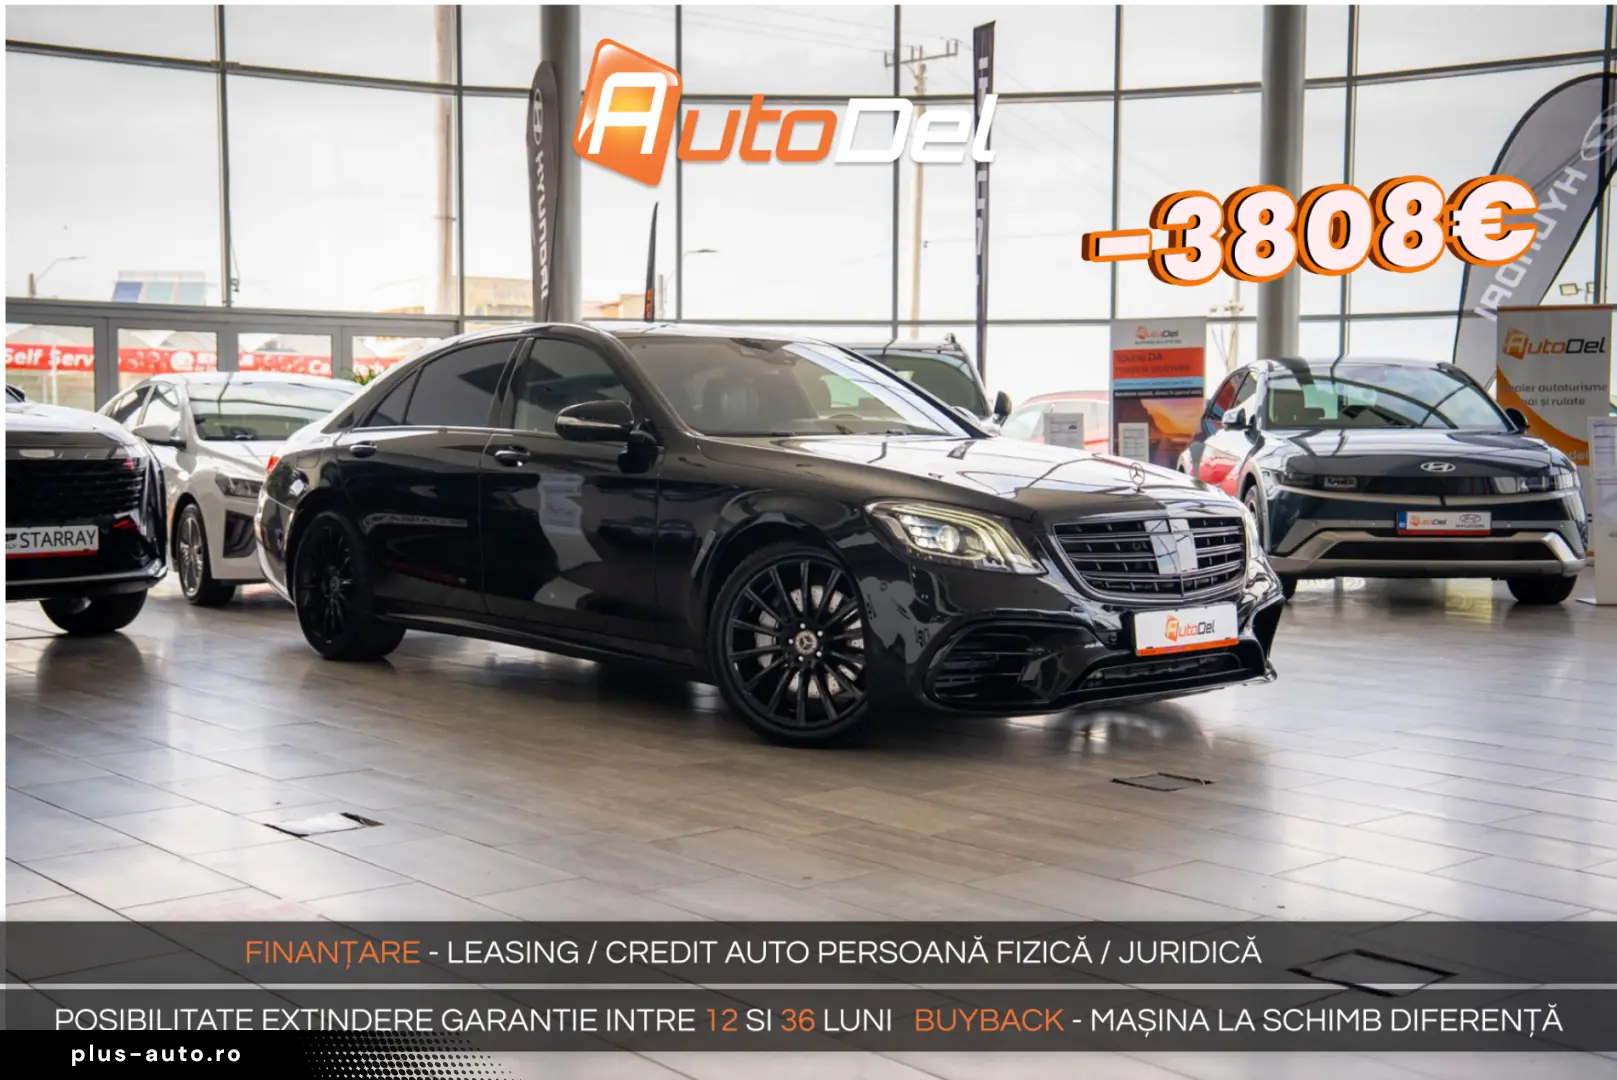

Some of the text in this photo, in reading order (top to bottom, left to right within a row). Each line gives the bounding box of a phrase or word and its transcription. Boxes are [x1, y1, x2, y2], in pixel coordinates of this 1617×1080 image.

[535, 149, 549, 300] HYUNDAI
[1505, 331, 1606, 355] AutoDel
[5, 348, 94, 366] Self Serv
[1538, 381, 1608, 393] autoturisme
[1551, 397, 1586, 406] rulate
[20, 529, 97, 549] STARRAY
[1166, 617, 1215, 640] AutoDel
